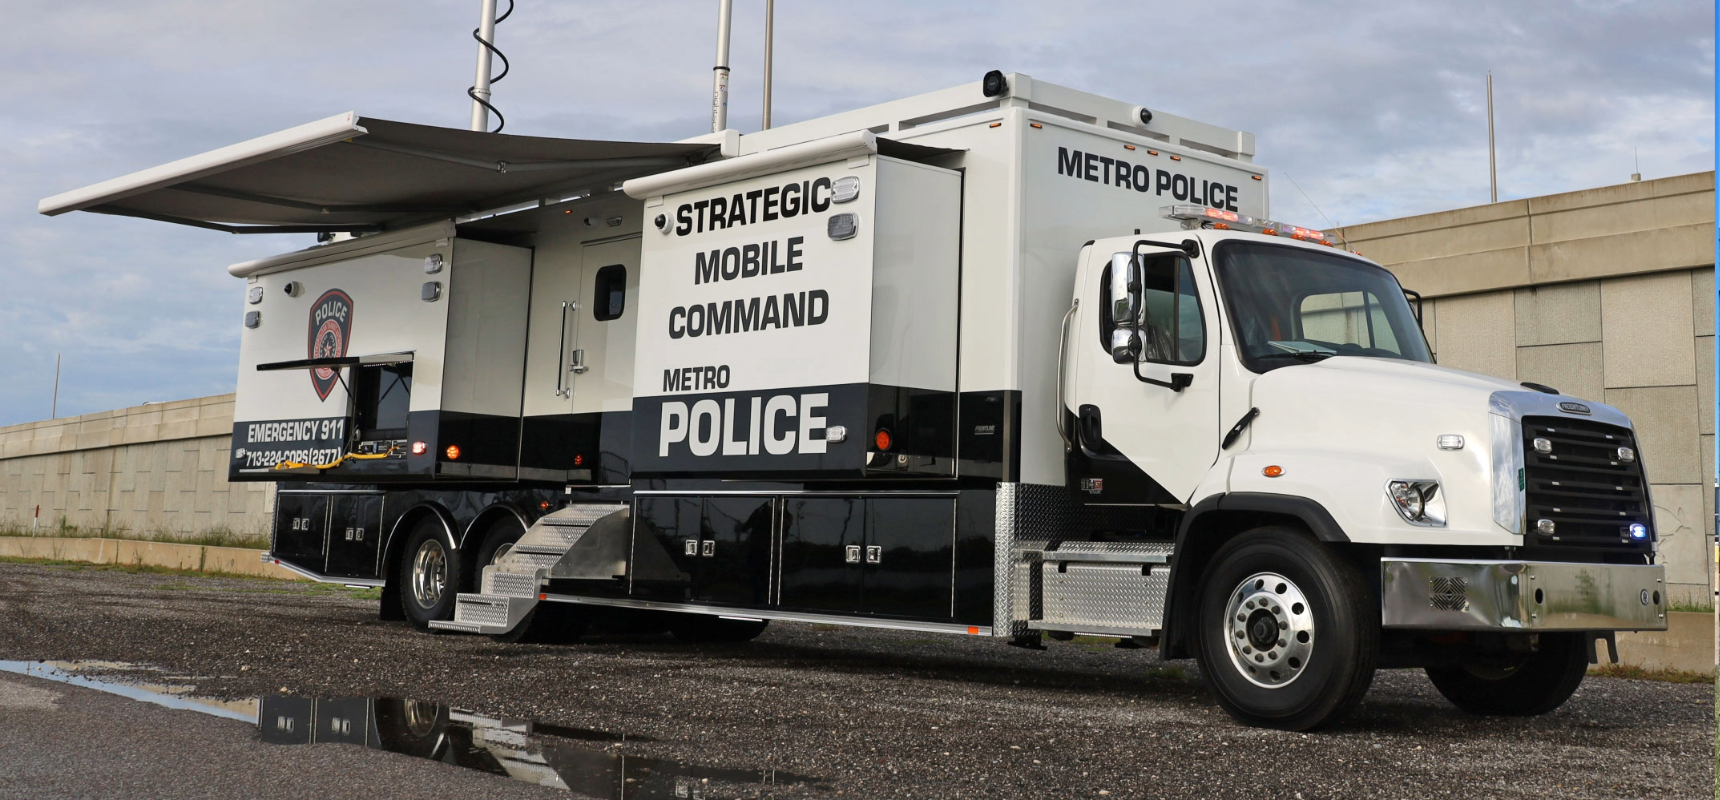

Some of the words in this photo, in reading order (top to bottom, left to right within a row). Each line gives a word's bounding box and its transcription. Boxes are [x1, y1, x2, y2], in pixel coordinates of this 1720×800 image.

[1058, 146, 1149, 193] METRO
[1156, 169, 1238, 212] POLICE
[676, 177, 831, 237] STRATEGIC
[694, 236, 804, 285] MOBILE
[315, 301, 347, 326] POLICE
[668, 289, 829, 339] COMMAND
[663, 365, 730, 392] METRO
[247, 420, 320, 443] EMERGENCY
[321, 419, 344, 440] 911
[659, 393, 829, 457] POLICE
